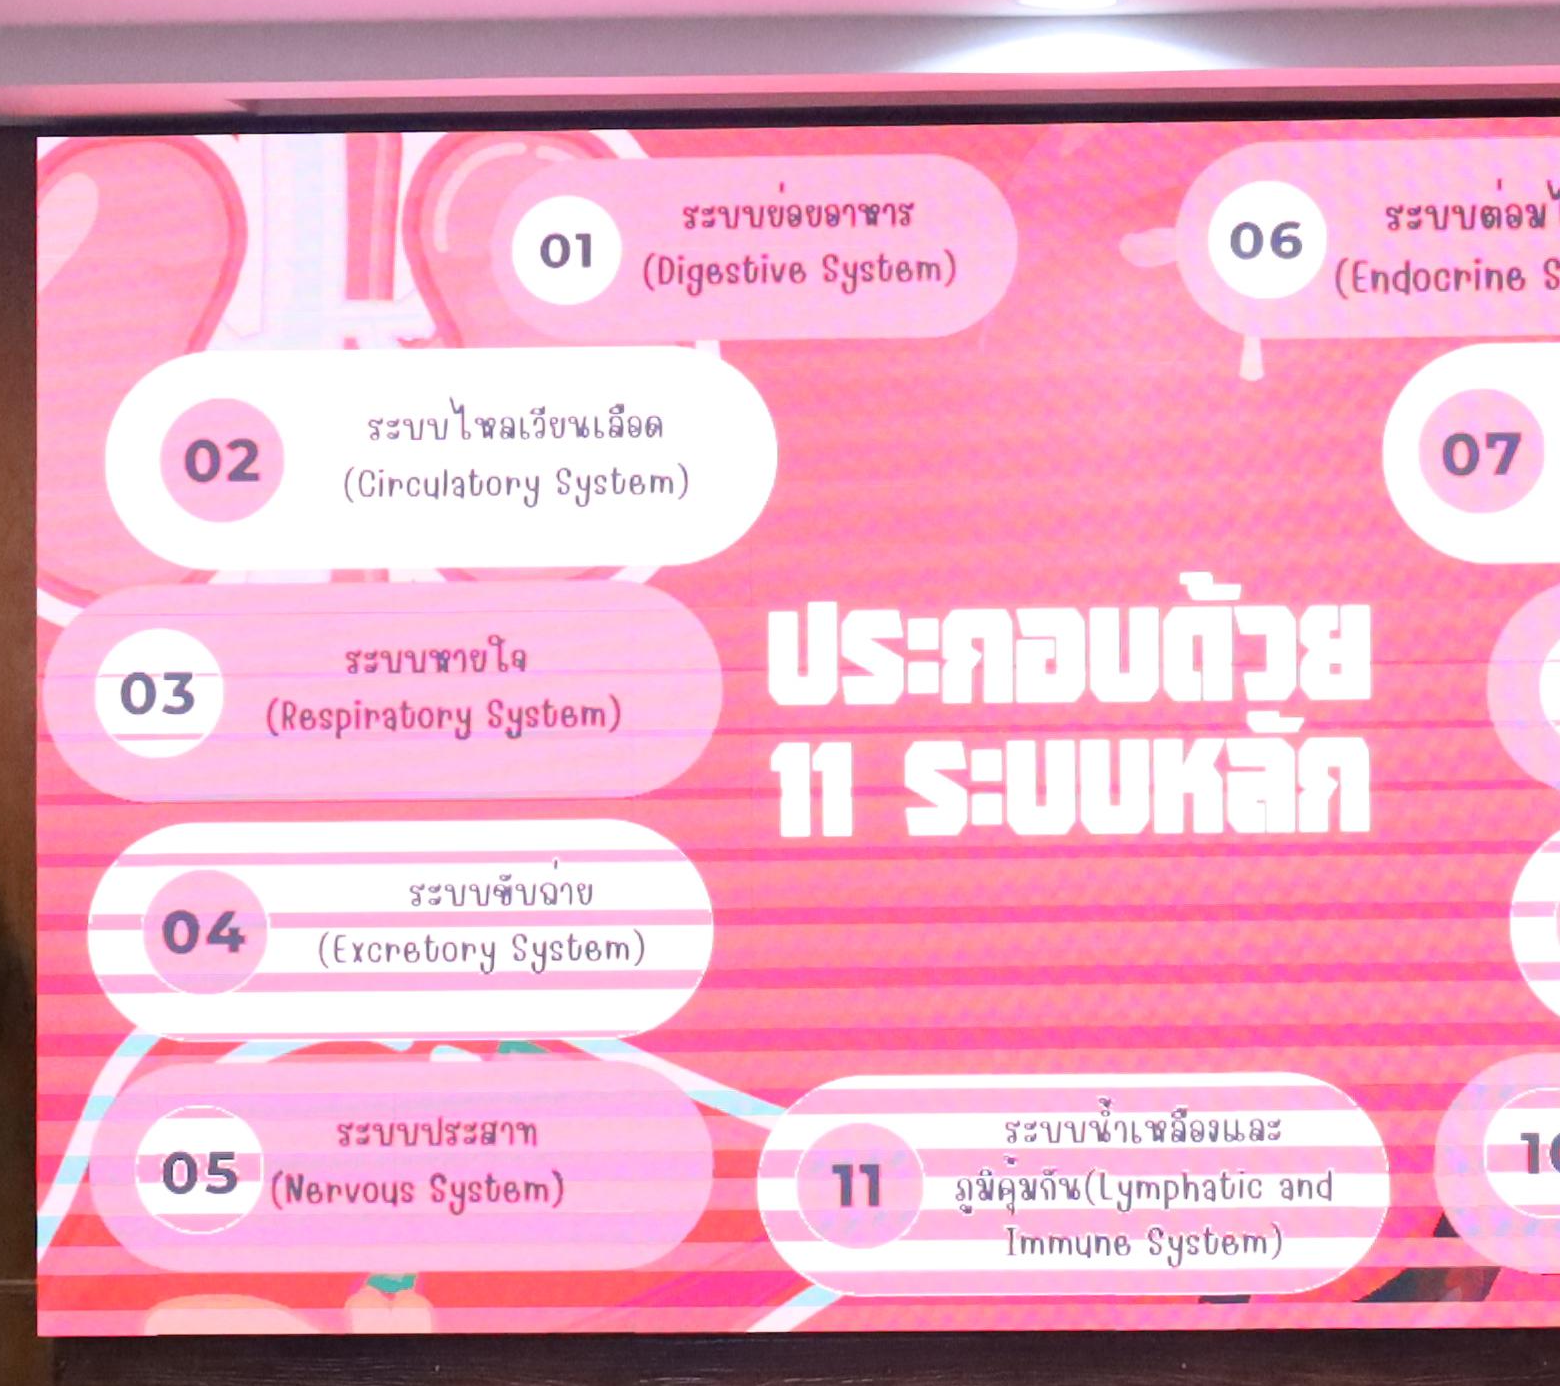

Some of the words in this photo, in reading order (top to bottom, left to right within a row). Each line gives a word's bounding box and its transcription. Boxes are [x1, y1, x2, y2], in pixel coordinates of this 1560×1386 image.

[683, 181, 915, 230] ระบบย่อยอาหาร
[540, 233, 591, 268] 01
[1231, 221, 1302, 260] 06
[643, 252, 807, 297] (Digestive
[822, 249, 957, 295] System)
[1334, 255, 1526, 299] (Endocrine
[368, 397, 662, 440] ระบบไหลเวียนเลือด
[185, 439, 259, 482] 02
[1443, 432, 1521, 476] 07
[344, 467, 539, 508] (Circulatory
[556, 463, 688, 507] System)
[347, 636, 525, 674] ระบบหายใจ
[767, 571, 1371, 705] ประกอบด้วย
[121, 672, 194, 715] 03
[267, 698, 471, 740] (Respiratory
[489, 697, 620, 739] System)
[770, 741, 853, 837] 11
[903, 710, 1371, 836] ระบบหลัก
[162, 910, 245, 954] 04
[319, 932, 495, 974] (Excretory
[512, 929, 644, 974] System)
[337, 1117, 538, 1147] ระบบประสาท
[1006, 1098, 1280, 1144] ระบบน้ำเหลืองและ
[163, 1152, 237, 1194] 05
[273, 1170, 412, 1205] (Nervous
[430, 1171, 563, 1215] System)
[832, 1163, 879, 1207] 11
[1280, 1171, 1332, 1201] and
[1007, 1227, 1131, 1258] Immune
[1148, 1224, 1282, 1267] System)
